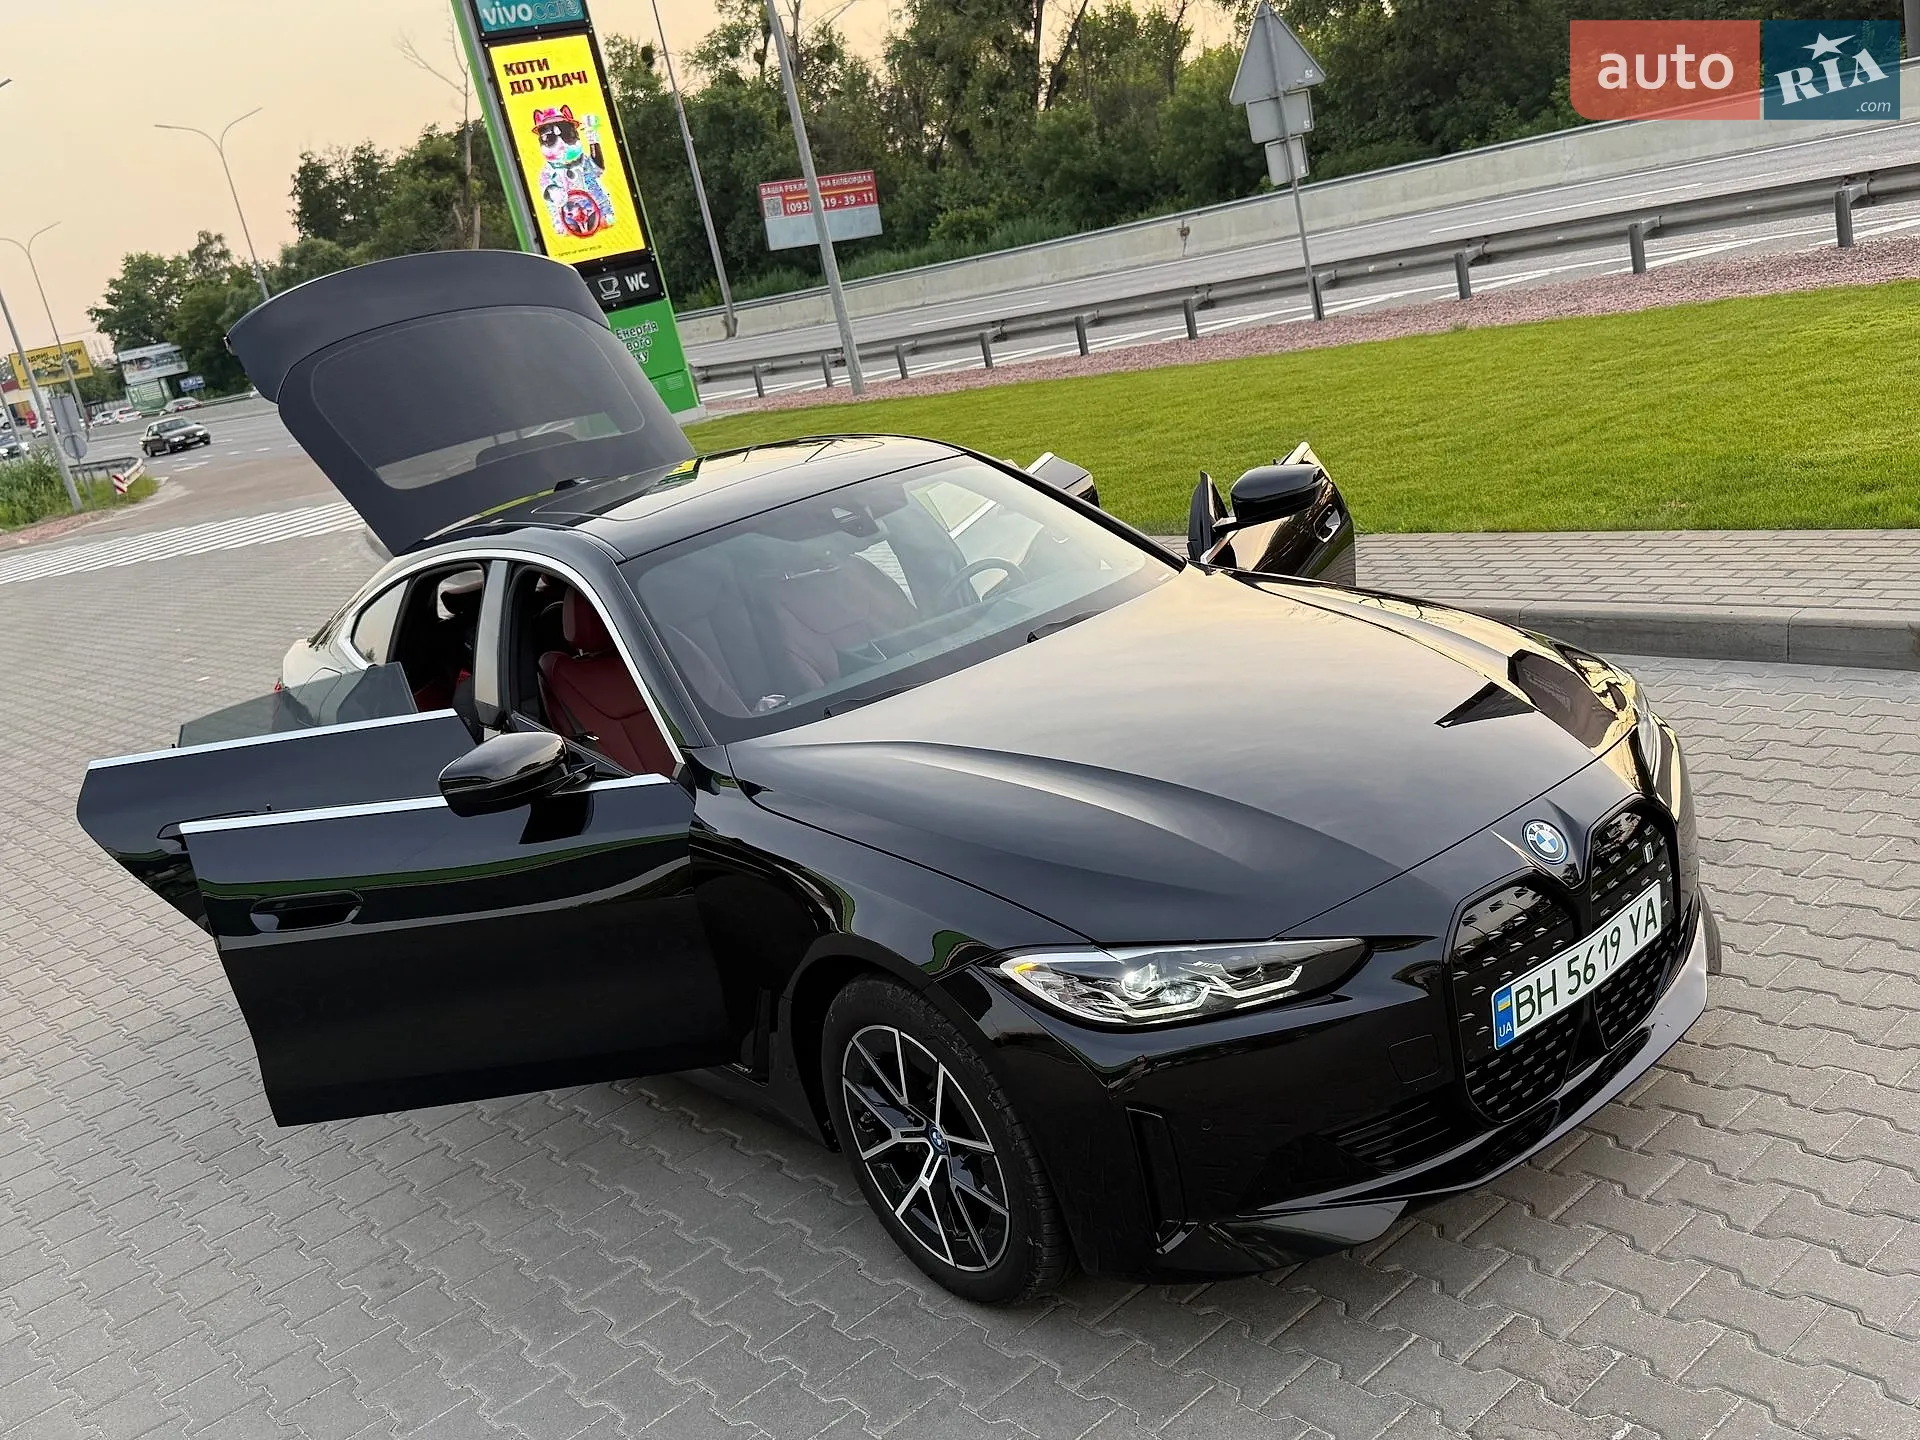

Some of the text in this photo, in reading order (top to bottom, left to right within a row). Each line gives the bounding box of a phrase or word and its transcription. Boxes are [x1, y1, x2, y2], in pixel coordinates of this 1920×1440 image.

[503, 58, 550, 77] КОТИ
[509, 71, 588, 96] ДО УДАЧІ
[761, 184, 784, 196] ВАША
[784, 182, 820, 193] РЕКЛА
[820, 179, 831, 188] НА
[786, 200, 812, 214] (093)
[821, 197, 837, 209] 19
[624, 271, 650, 292] WC
[615, 321, 658, 340] Енергія
[626, 337, 652, 351] вого
[1514, 896, 1659, 1028] BH 5619 YA
[1498, 1023, 1513, 1038] UA
